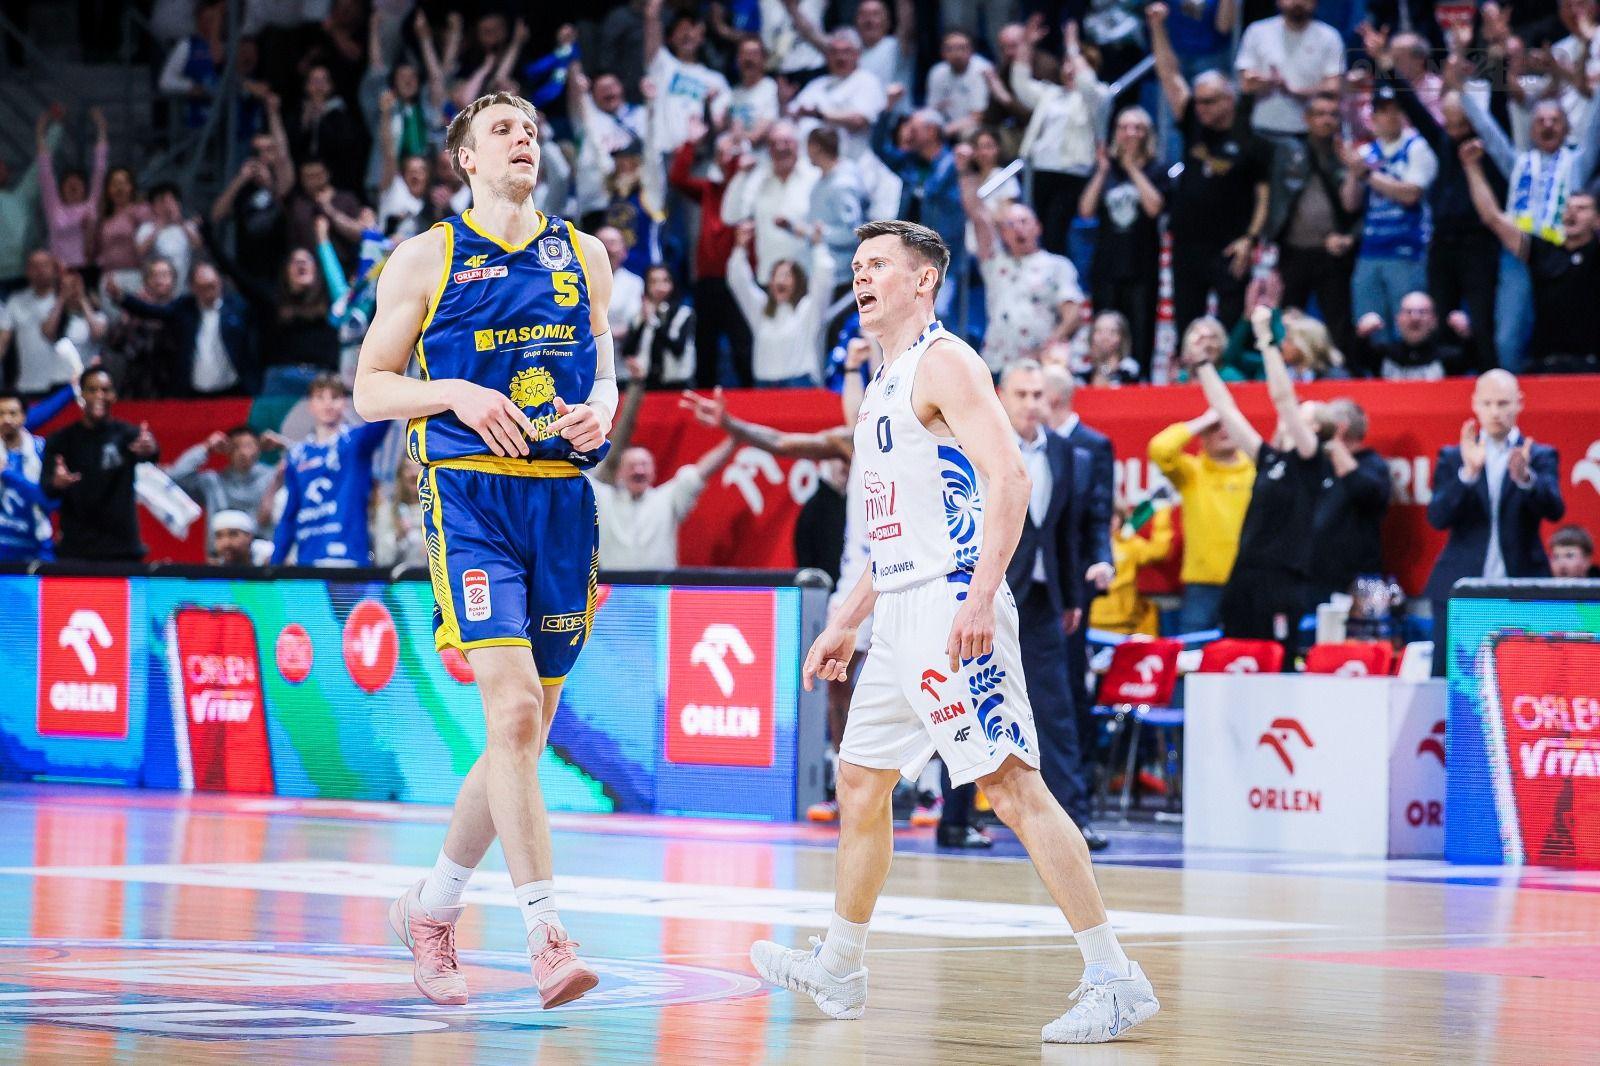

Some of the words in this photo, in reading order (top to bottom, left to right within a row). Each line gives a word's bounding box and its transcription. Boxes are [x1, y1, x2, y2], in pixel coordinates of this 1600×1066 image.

[456, 269, 482, 281] ORLEN
[552, 272, 579, 306] 5
[495, 324, 576, 345] TASOMIX
[523, 350, 541, 358] Grupa
[50, 682, 117, 713] ORLEN
[680, 704, 760, 737] ORLEN
[930, 701, 966, 726] ORLEN
[954, 726, 971, 742] 4F
[1249, 787, 1321, 812] ORLEN
